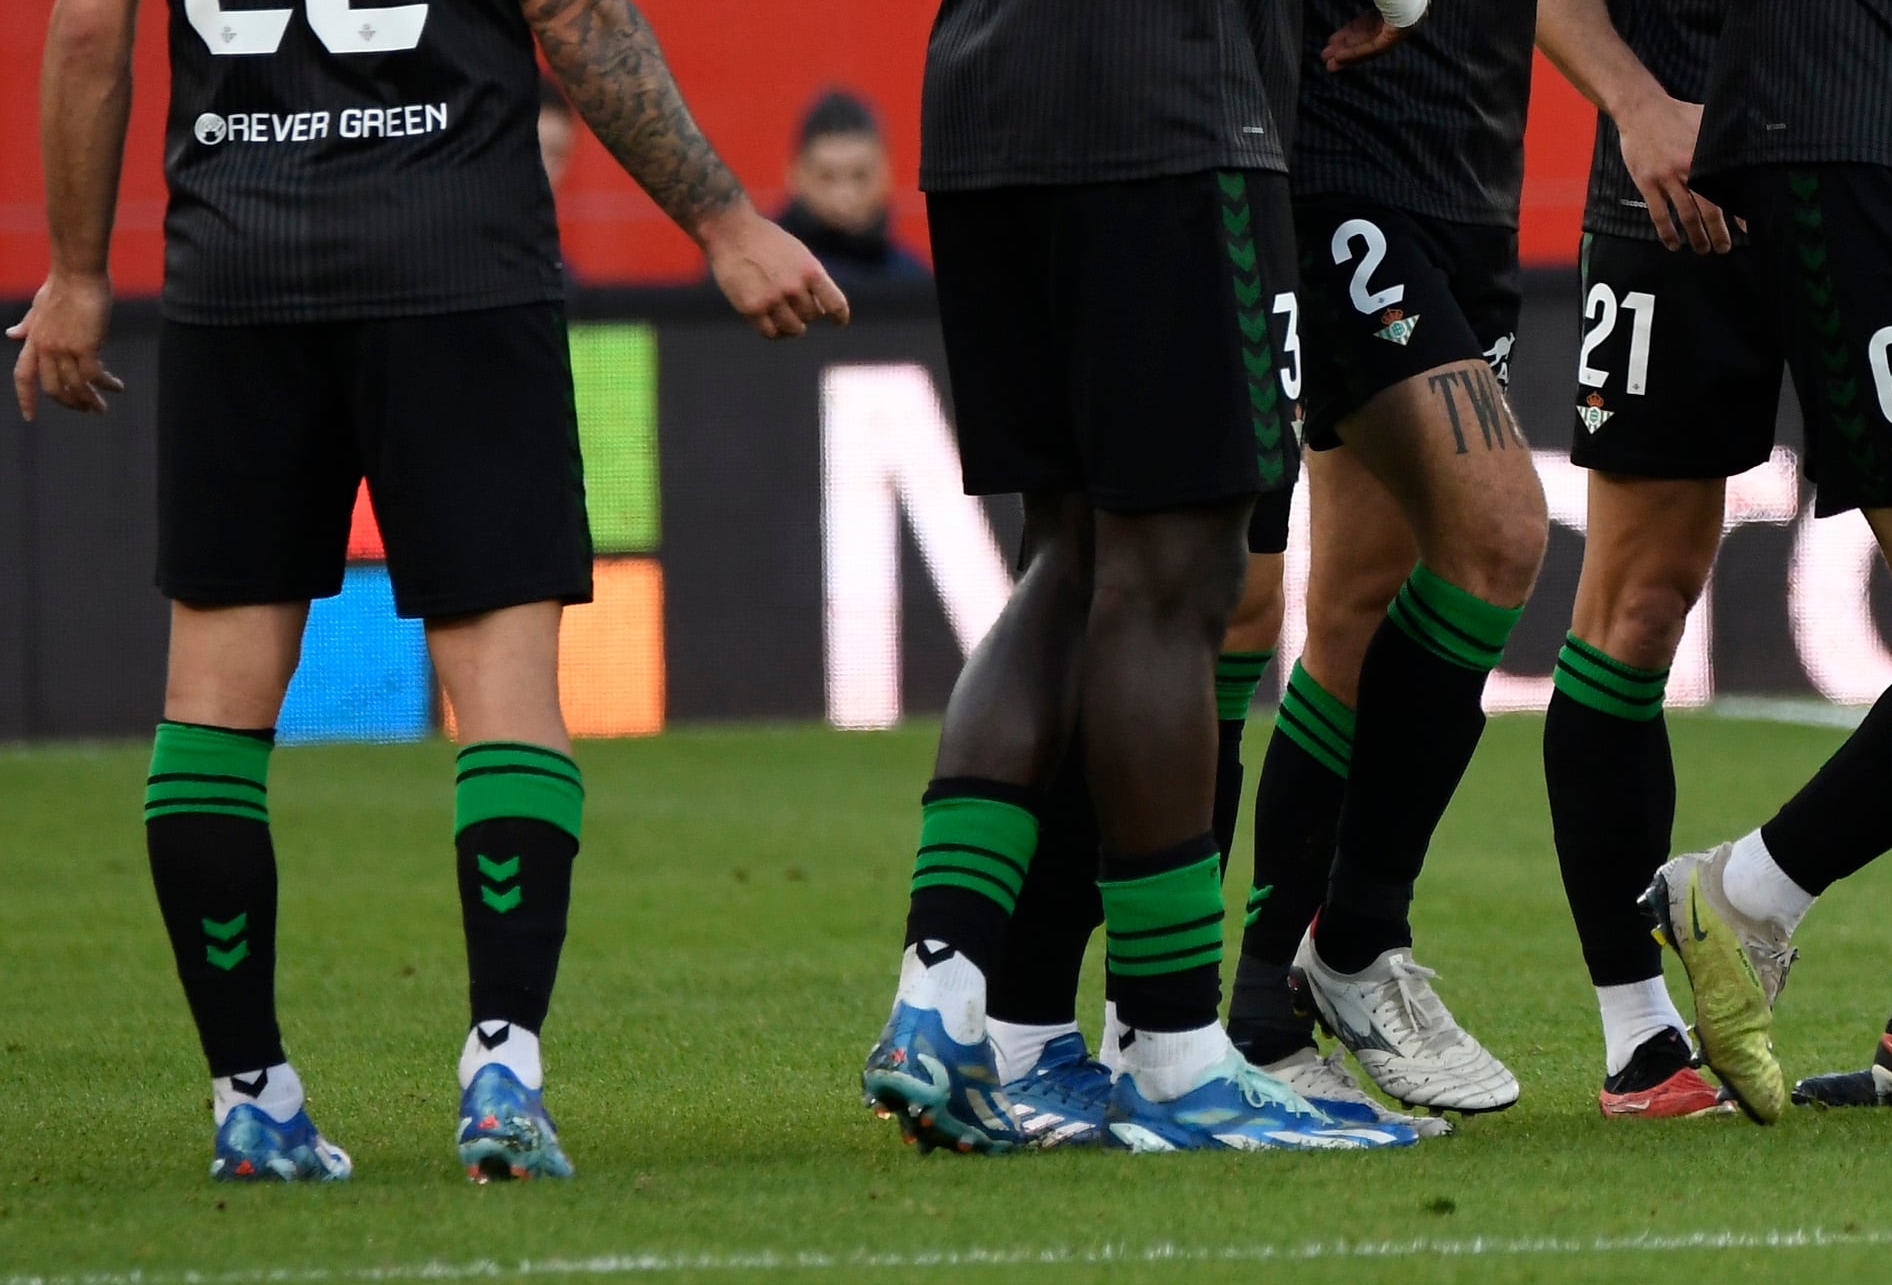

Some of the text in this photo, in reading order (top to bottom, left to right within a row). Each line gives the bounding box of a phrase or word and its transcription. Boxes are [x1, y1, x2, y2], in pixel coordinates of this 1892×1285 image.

[339, 102, 445, 139] GREEN
[1331, 218, 1405, 315] 2
[1577, 281, 1656, 396] 21
